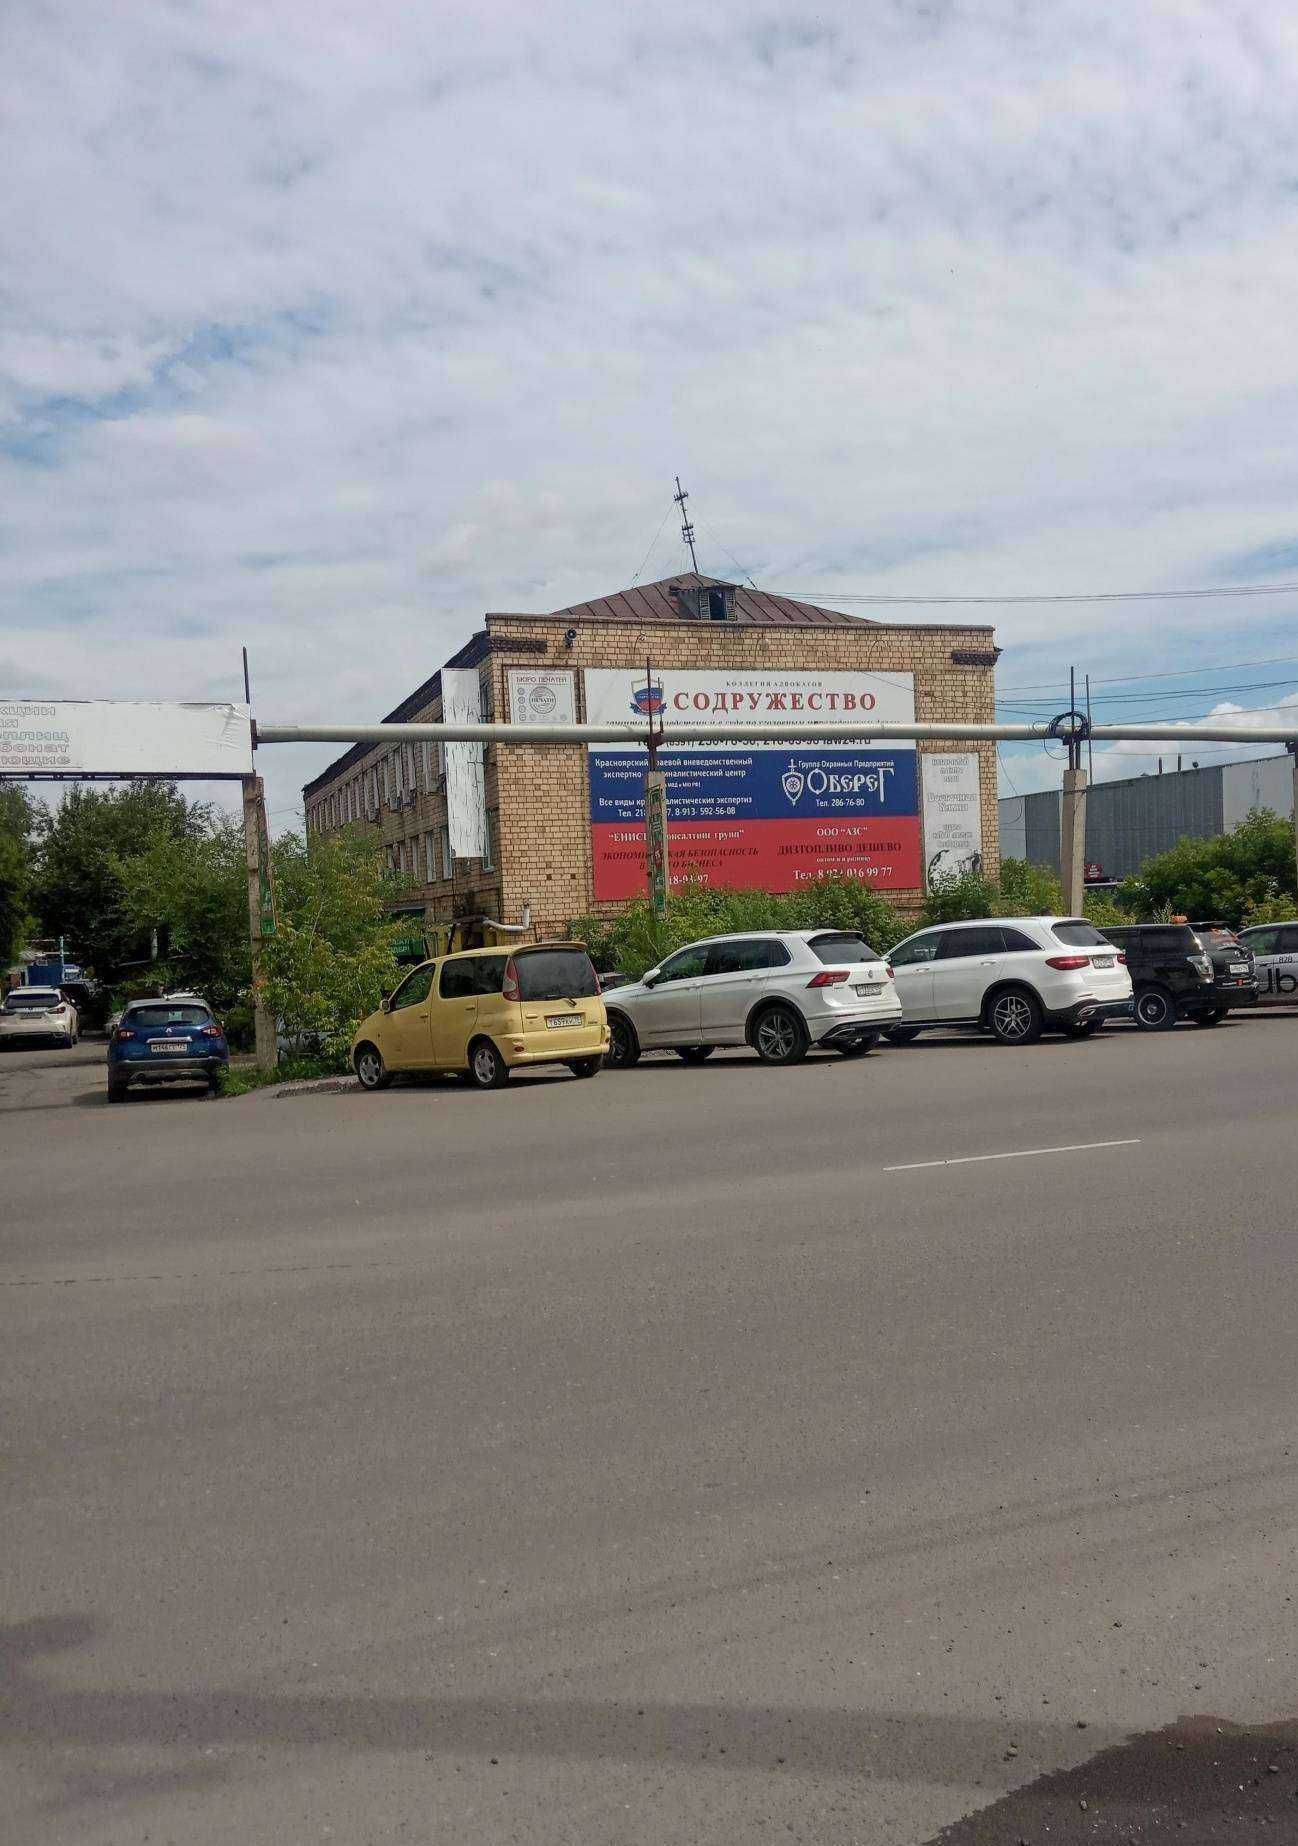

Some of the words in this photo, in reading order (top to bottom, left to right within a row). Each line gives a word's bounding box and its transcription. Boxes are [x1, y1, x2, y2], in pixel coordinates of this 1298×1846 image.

[673, 692, 877, 714] СОДРУЖЕСТВО
[595, 758, 649, 768] Красноярский
[683, 757, 753, 767] вневедомственный
[798, 760, 820, 769] Группа
[821, 760, 852, 769] Охранных
[854, 759, 895, 768] Предприятий
[603, 771, 644, 780] экспертно-
[724, 770, 747, 778] центр
[598, 797, 613, 806] Все
[614, 799, 635, 807] виды
[716, 797, 753, 806] экспертиз
[831, 798, 865, 807] 286-76-80
[816, 828, 839, 836] ООО
[687, 847, 760, 858] БЕЗОПАСНОСТЬ
[777, 844, 853, 856] ДИЗТОПЛИВО
[855, 842, 901, 853] ДЕШЕВО
[867, 867, 879, 877] 99
[881, 866, 893, 876] 77
